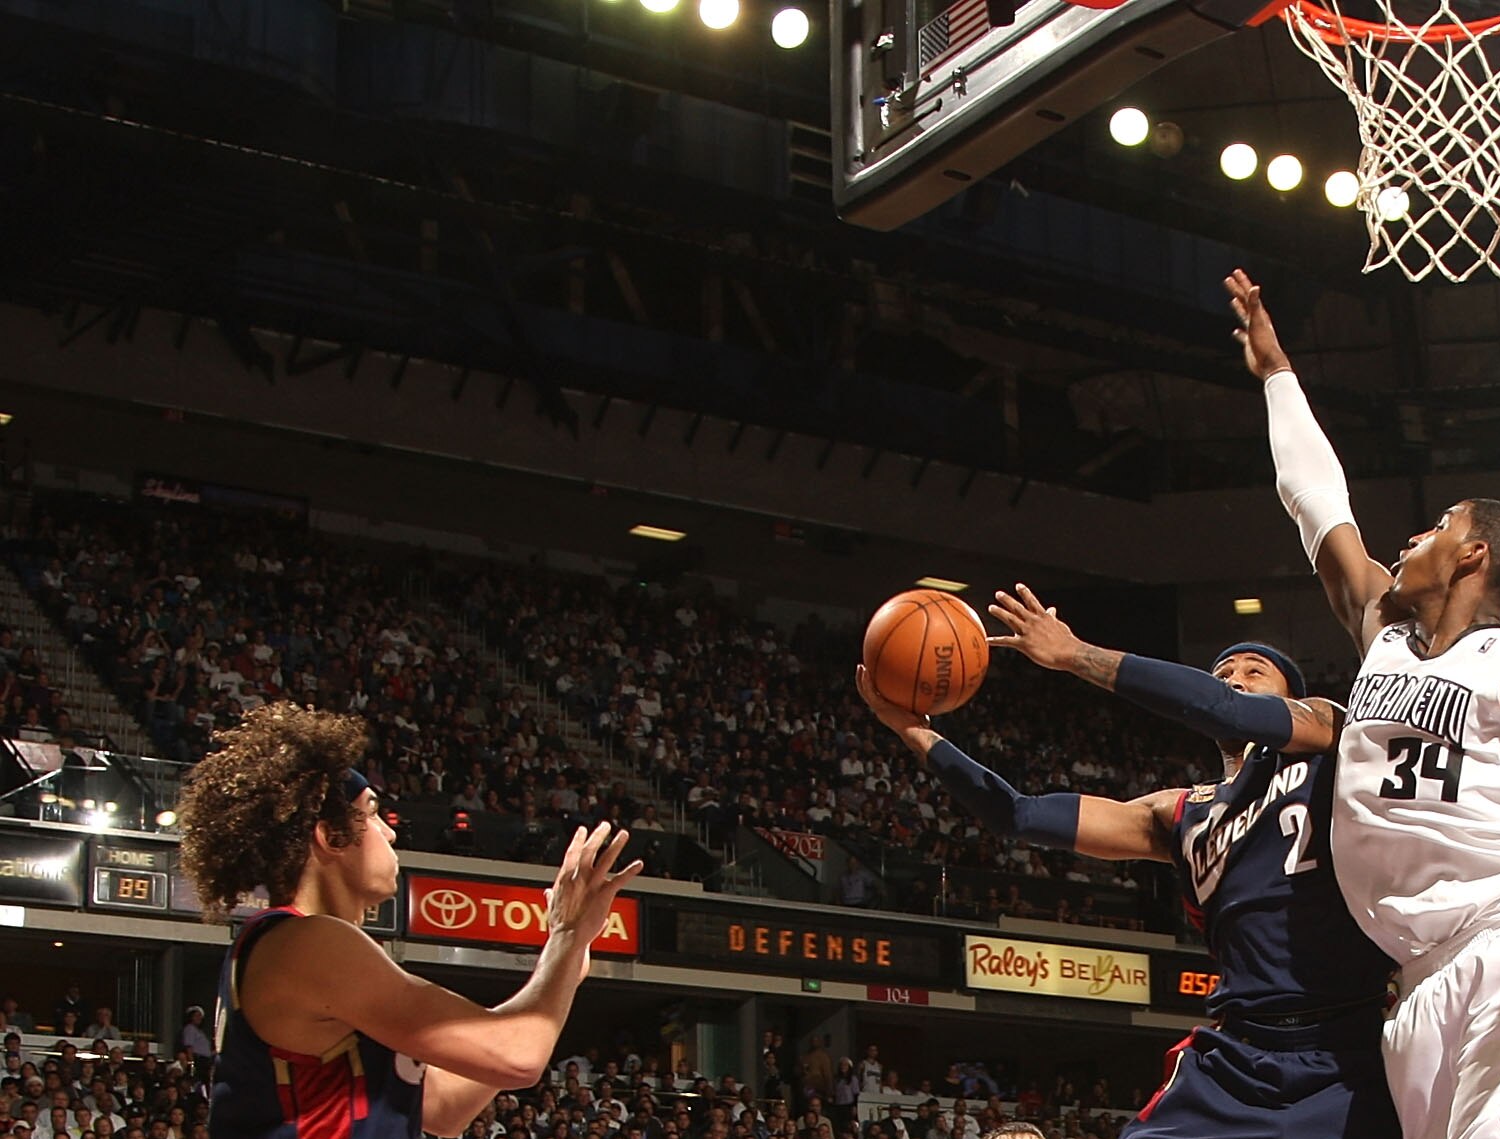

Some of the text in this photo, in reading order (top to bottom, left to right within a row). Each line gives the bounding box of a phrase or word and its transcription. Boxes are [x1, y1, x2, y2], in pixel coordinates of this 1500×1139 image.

[1379, 736, 1464, 802] 34
[109, 851, 155, 867] HOME
[1279, 803, 1318, 876] 2
[118, 877, 149, 900] 89
[481, 897, 630, 941] TOYA
[728, 924, 892, 967] DEFENSE
[969, 943, 1050, 987] Raley's
[886, 987, 910, 1004] 104
